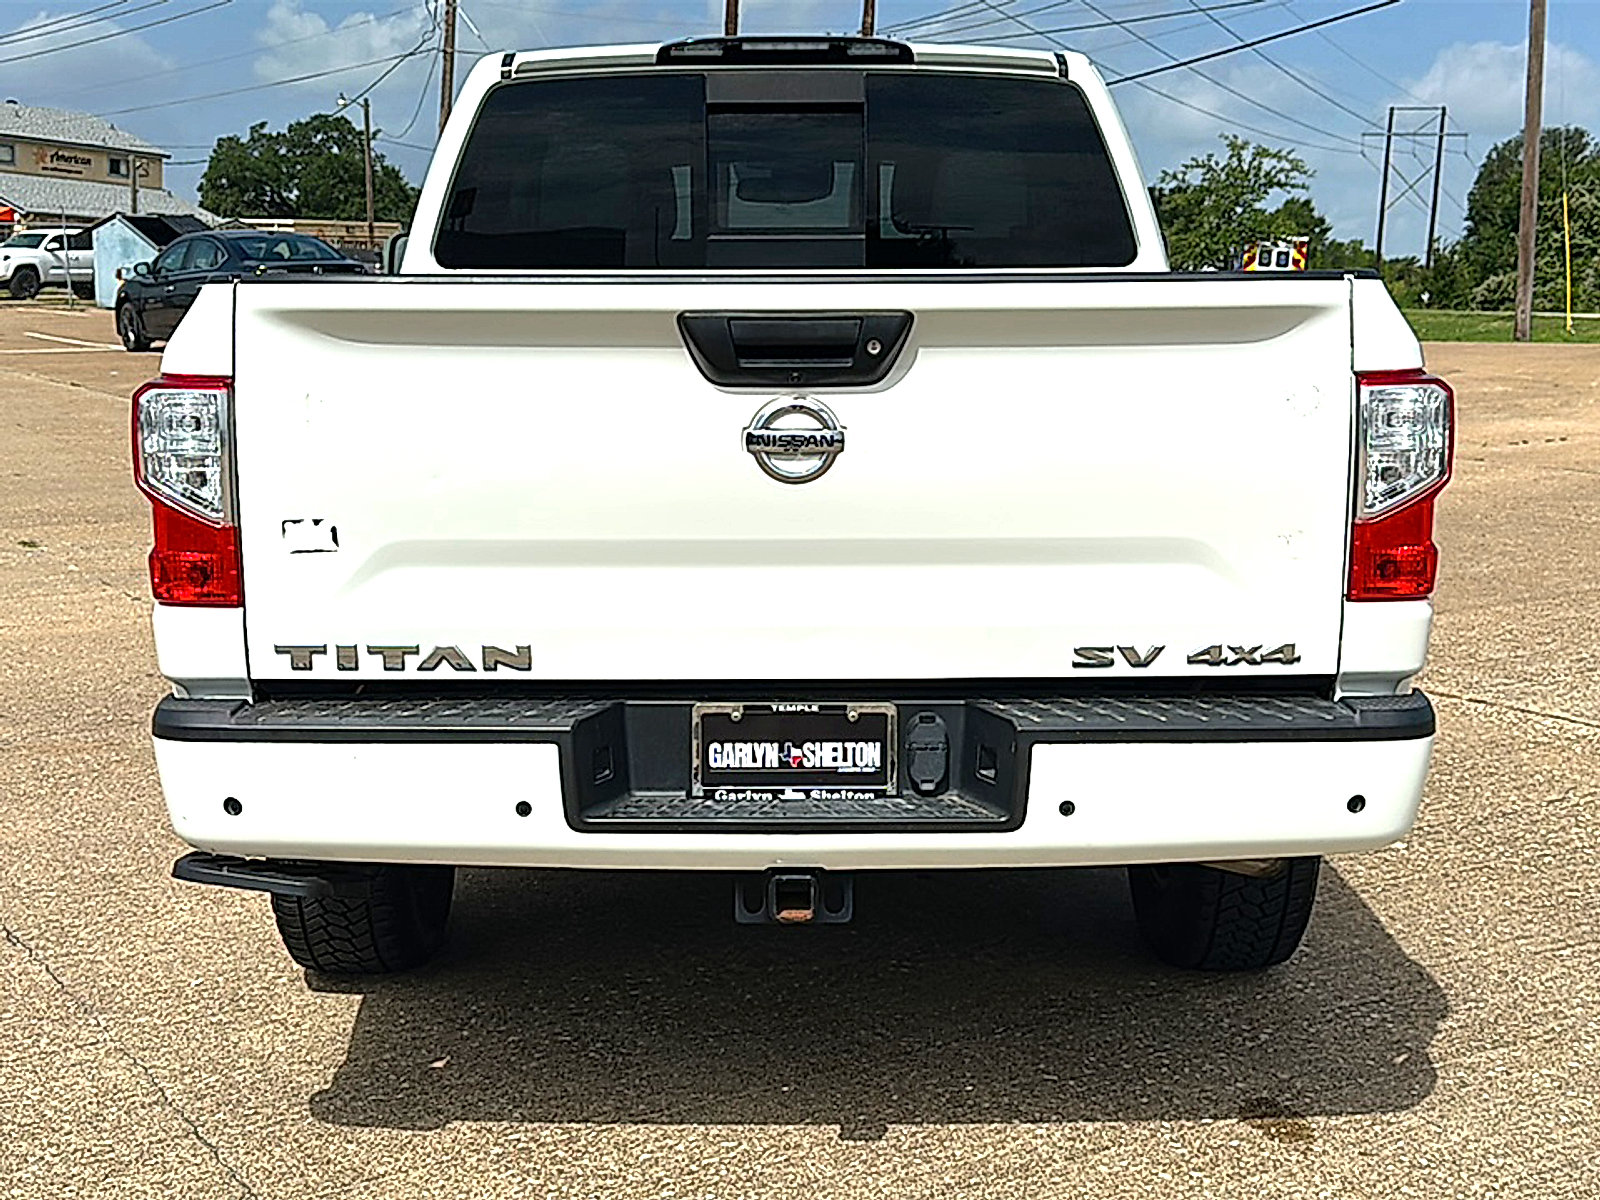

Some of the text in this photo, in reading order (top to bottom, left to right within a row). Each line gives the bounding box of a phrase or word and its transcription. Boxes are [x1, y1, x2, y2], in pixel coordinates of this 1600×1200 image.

[50, 150, 92, 166] American
[755, 434, 835, 448] NISSAN
[274, 644, 532, 672] TITAN
[1072, 645, 1165, 668] SV
[771, 704, 820, 713] TEMPLE
[708, 741, 881, 768] GARLYN SHELTON
[714, 790, 875, 800] Garlyn Shelton
